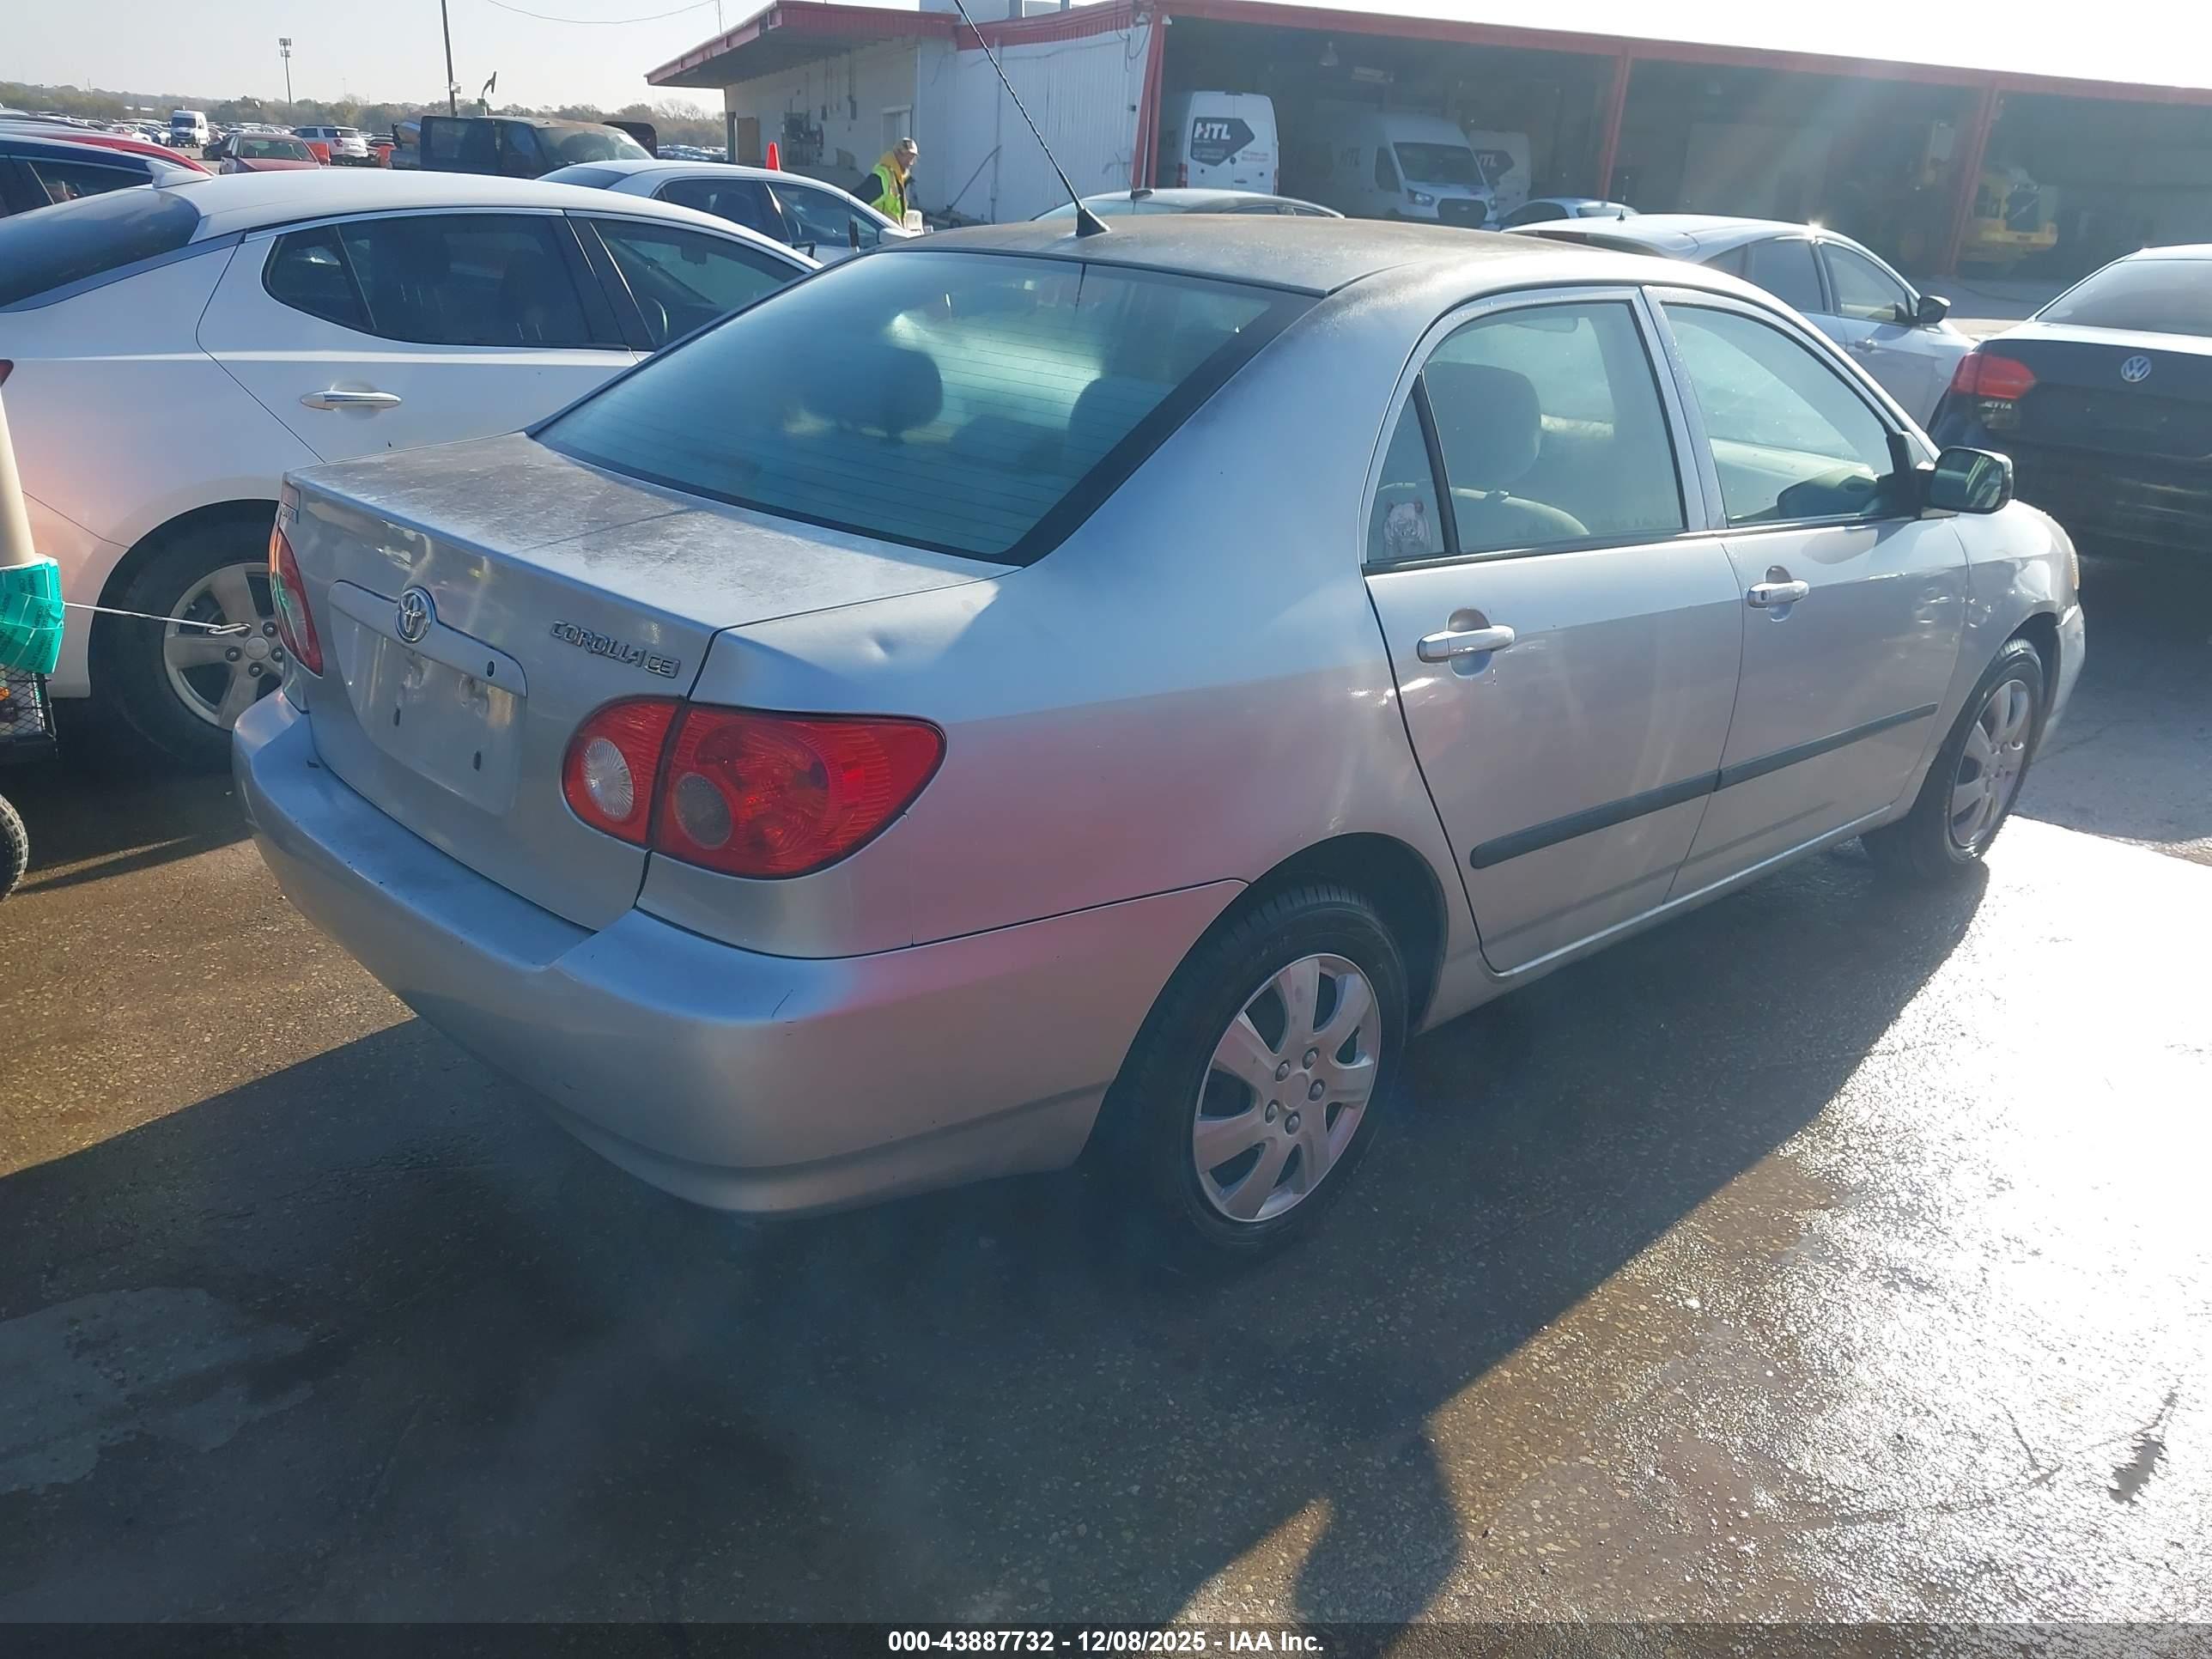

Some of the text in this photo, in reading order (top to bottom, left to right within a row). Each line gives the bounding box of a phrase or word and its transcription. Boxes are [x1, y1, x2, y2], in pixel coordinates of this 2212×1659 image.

[1194, 123, 1231, 140] HTL
[550, 618, 681, 678] COROLLA CE
